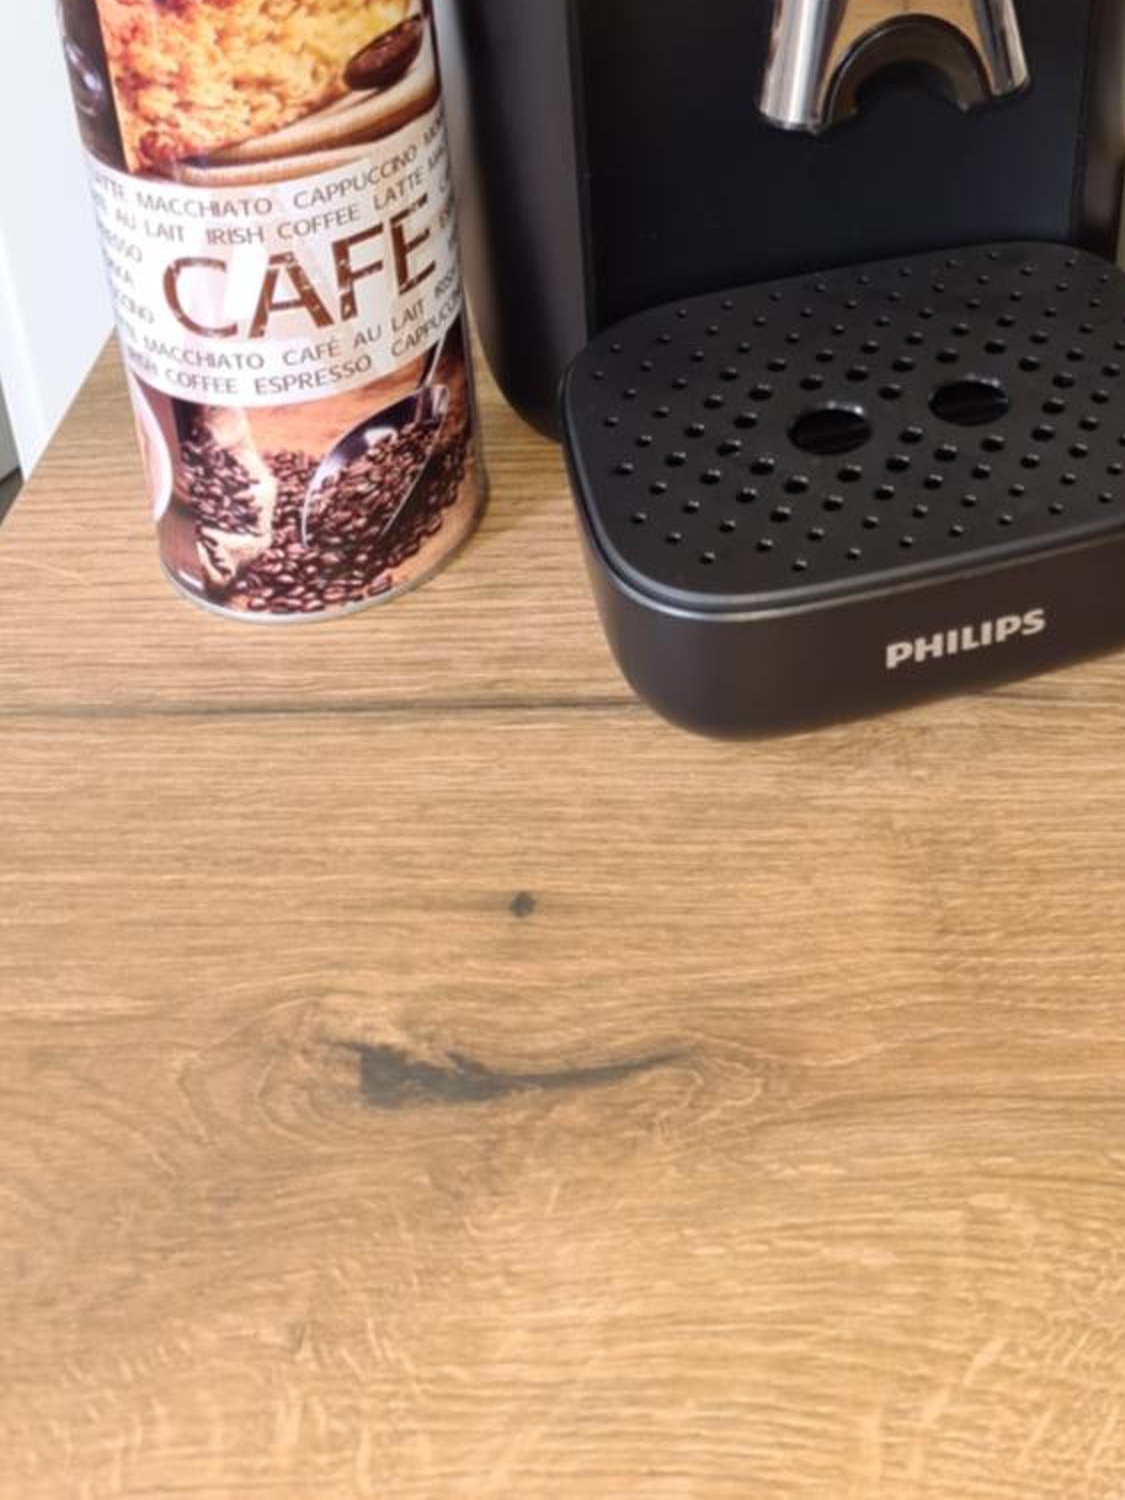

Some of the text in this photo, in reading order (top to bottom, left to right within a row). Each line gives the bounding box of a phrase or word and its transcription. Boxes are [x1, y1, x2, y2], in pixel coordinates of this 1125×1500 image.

[135, 191, 273, 217] MACCHIATO
[292, 144, 417, 210] CAPPUCCINO
[144, 219, 184, 243] LAIT
[205, 225, 265, 245] IRISH
[276, 202, 361, 241] COFFEE
[372, 164, 424, 211] LATTE
[143, 336, 265, 370] MACCHIATO
[353, 324, 382, 349] AU
[391, 298, 423, 332] LAIT
[165, 368, 238, 395] COFFEE
[254, 354, 372, 395] ESPRESSO
[885, 608, 1046, 669] PHILIPS
